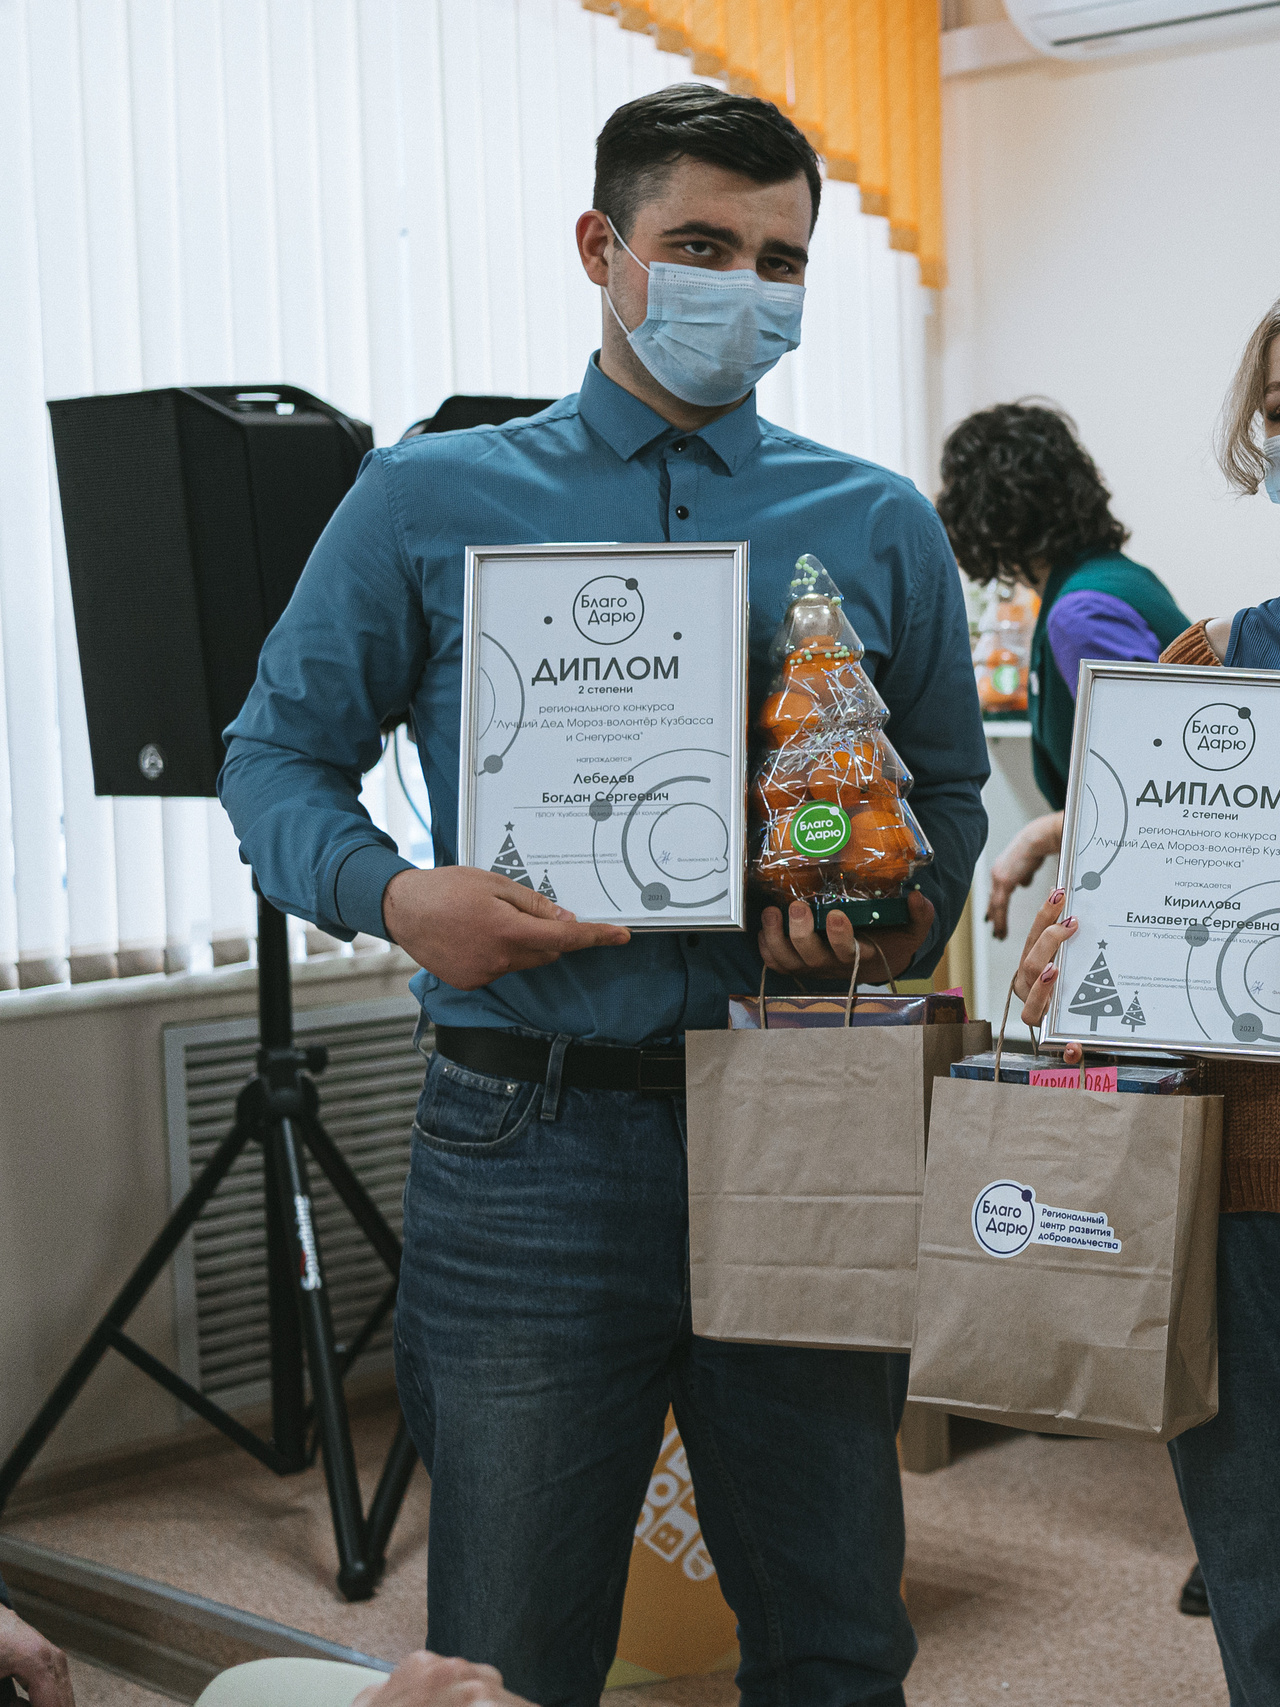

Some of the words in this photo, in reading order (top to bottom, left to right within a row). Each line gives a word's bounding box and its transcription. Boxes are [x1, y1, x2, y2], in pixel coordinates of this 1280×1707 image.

[581, 594, 627, 608] Благо
[588, 609, 636, 626] Дарю
[531, 656, 679, 686] ДИПЛОМ
[578, 685, 584, 694] 2
[587, 685, 633, 694] степени
[539, 705, 620, 714] регионального
[623, 703, 675, 714] конкурса
[493, 719, 538, 730] "Лучший
[540, 718, 564, 728] Дед
[567, 716, 658, 728] Мороз-волонтёр
[660, 715, 714, 726] Кузбасса
[1192, 720, 1239, 735] Благо
[566, 734, 573, 742] и
[575, 731, 643, 743] Снегурочка"
[1197, 735, 1246, 753] Дарю
[573, 772, 635, 784] Лебедев
[542, 792, 591, 804] Богдан
[594, 790, 669, 804] Сергеевич
[1182, 809, 1189, 818] 2
[1192, 810, 1239, 821] степени
[800, 819, 834, 831] Благо
[805, 829, 842, 842] Дарю
[1138, 826, 1222, 839] регионального
[1224, 832, 1277, 842] конкурса
[1093, 837, 1138, 849] "Лучший
[1140, 841, 1165, 851] Дед
[1168, 841, 1260, 856] Мороз-волонтёр
[1165, 857, 1173, 865] и
[1175, 856, 1245, 868] Снегурочка"
[1174, 880, 1232, 890] награждается
[648, 893, 663, 901] 2021
[1164, 895, 1241, 910] Кириллова
[1126, 911, 1198, 927] Елизавета
[1202, 916, 1280, 931] Сергеевна
[1239, 1025, 1256, 1033] 2021
[982, 1200, 1022, 1218] Благо
[1041, 1208, 1105, 1225] Региональный
[985, 1217, 1028, 1236] Дарю
[1040, 1220, 1066, 1232] центр
[1068, 1225, 1111, 1237] развития
[1037, 1232, 1119, 1250] добровольчества
